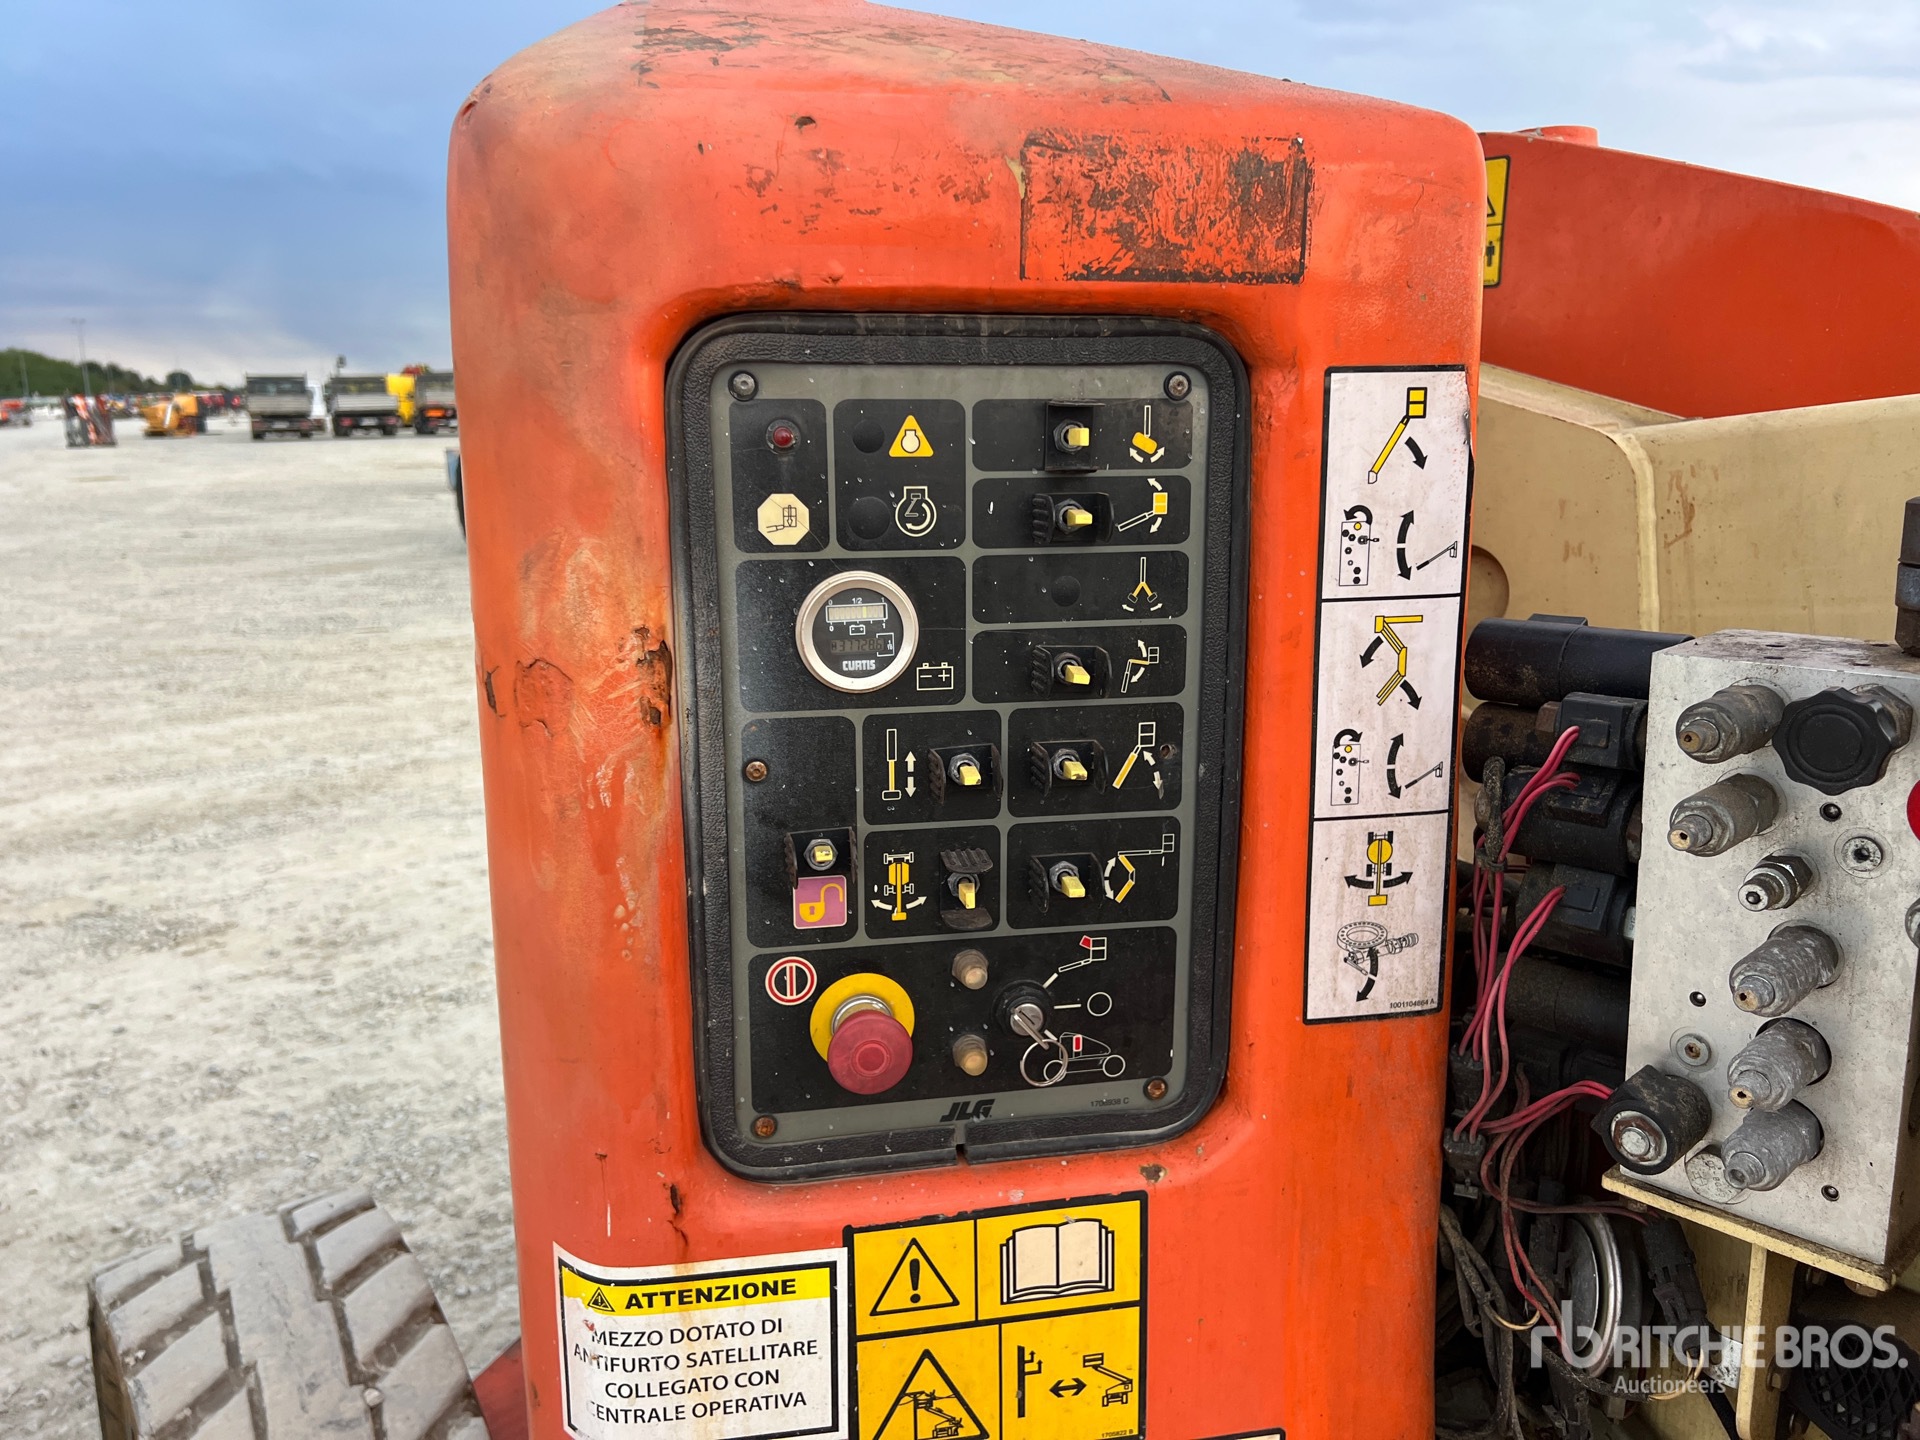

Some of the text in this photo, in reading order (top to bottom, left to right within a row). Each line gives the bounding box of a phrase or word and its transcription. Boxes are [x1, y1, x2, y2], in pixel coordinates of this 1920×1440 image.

[842, 660, 876, 671] CURTIS
[939, 1098, 996, 1123] JLG
[625, 1278, 797, 1310] ATTENZIONE
[592, 1318, 783, 1348] MEZZO DOTATO DI
[573, 1339, 818, 1373] ANTIFURTO SATELLITARE
[605, 1369, 780, 1398] COLLEGATO CON
[692, 1391, 807, 1418] OPERATIVA
